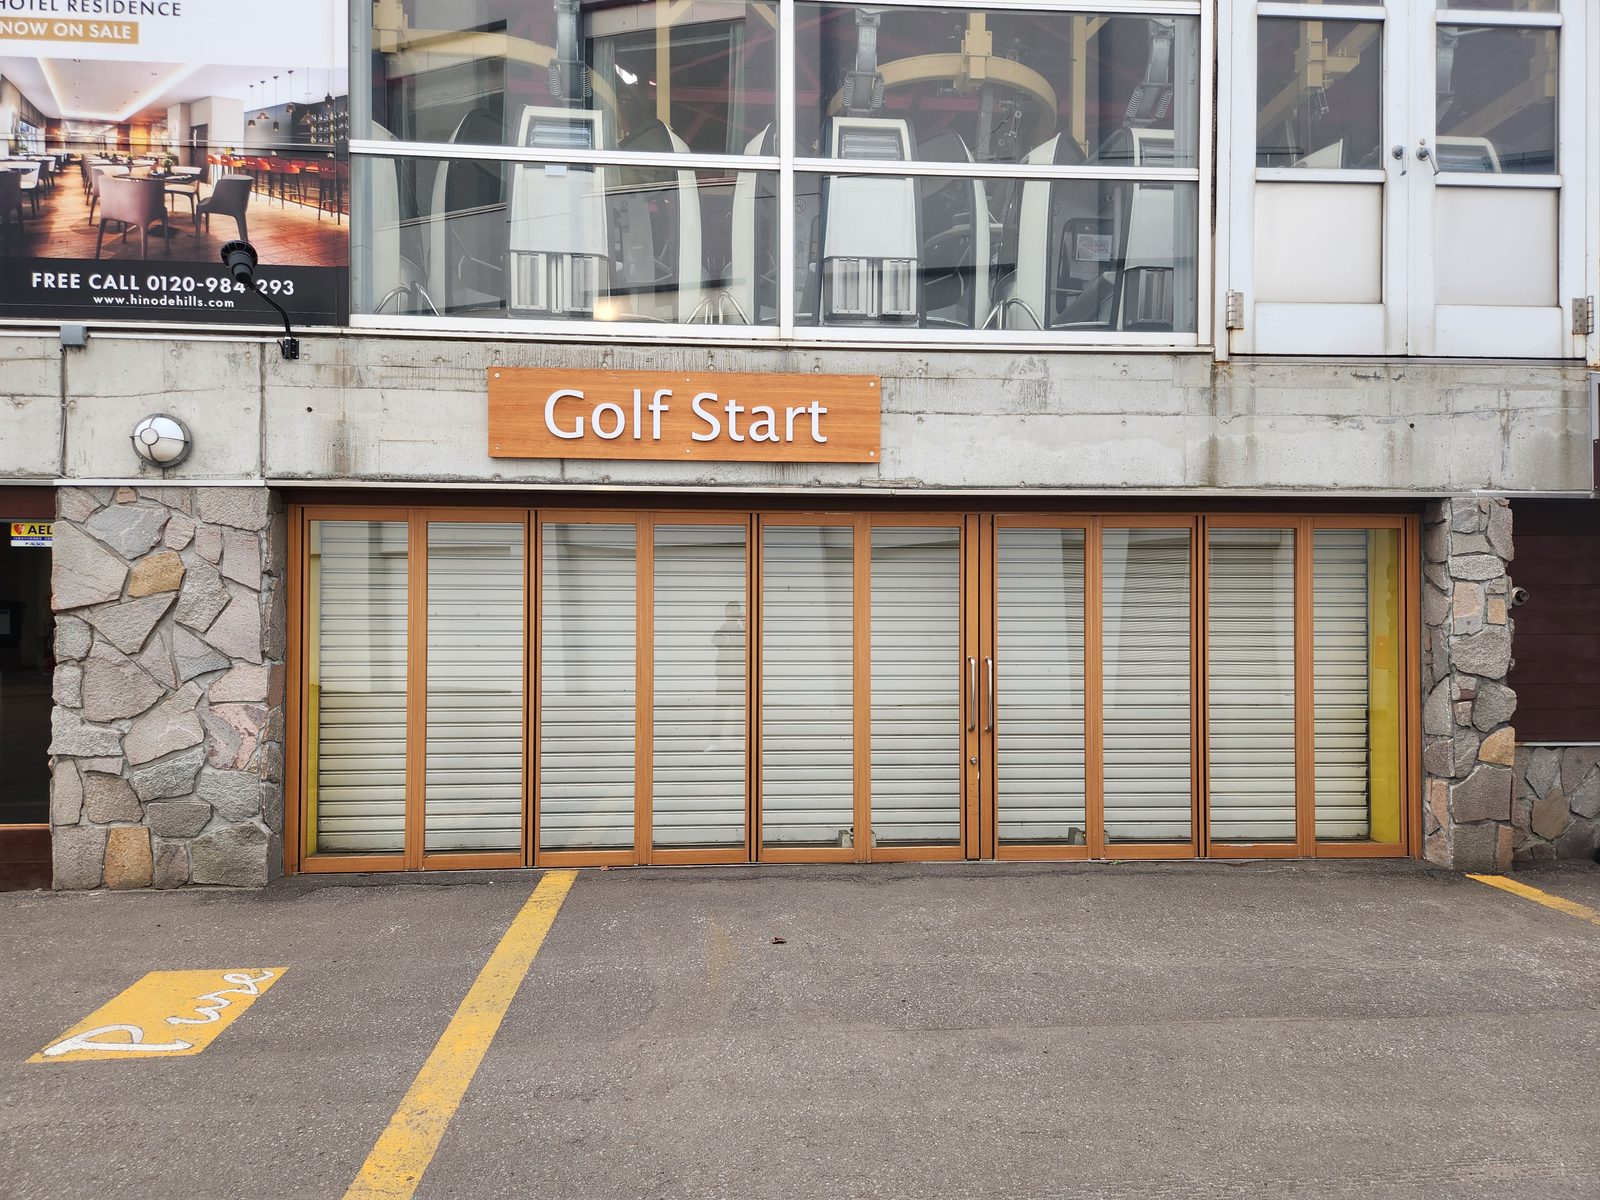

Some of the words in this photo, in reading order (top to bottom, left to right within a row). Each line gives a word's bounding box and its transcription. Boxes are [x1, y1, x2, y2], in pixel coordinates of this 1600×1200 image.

[67, 0, 181, 17] RESIDENCE
[0, 20, 48, 36] NOW
[53, 22, 84, 38] ON
[89, 24, 132, 40] SALE
[31, 272, 81, 289] FREE
[88, 273, 140, 291] CALL
[146, 275, 295, 296] 0120-984293
[92, 293, 235, 308] www.hinodehills.com
[544, 388, 673, 440] Golf
[691, 392, 828, 444] Start
